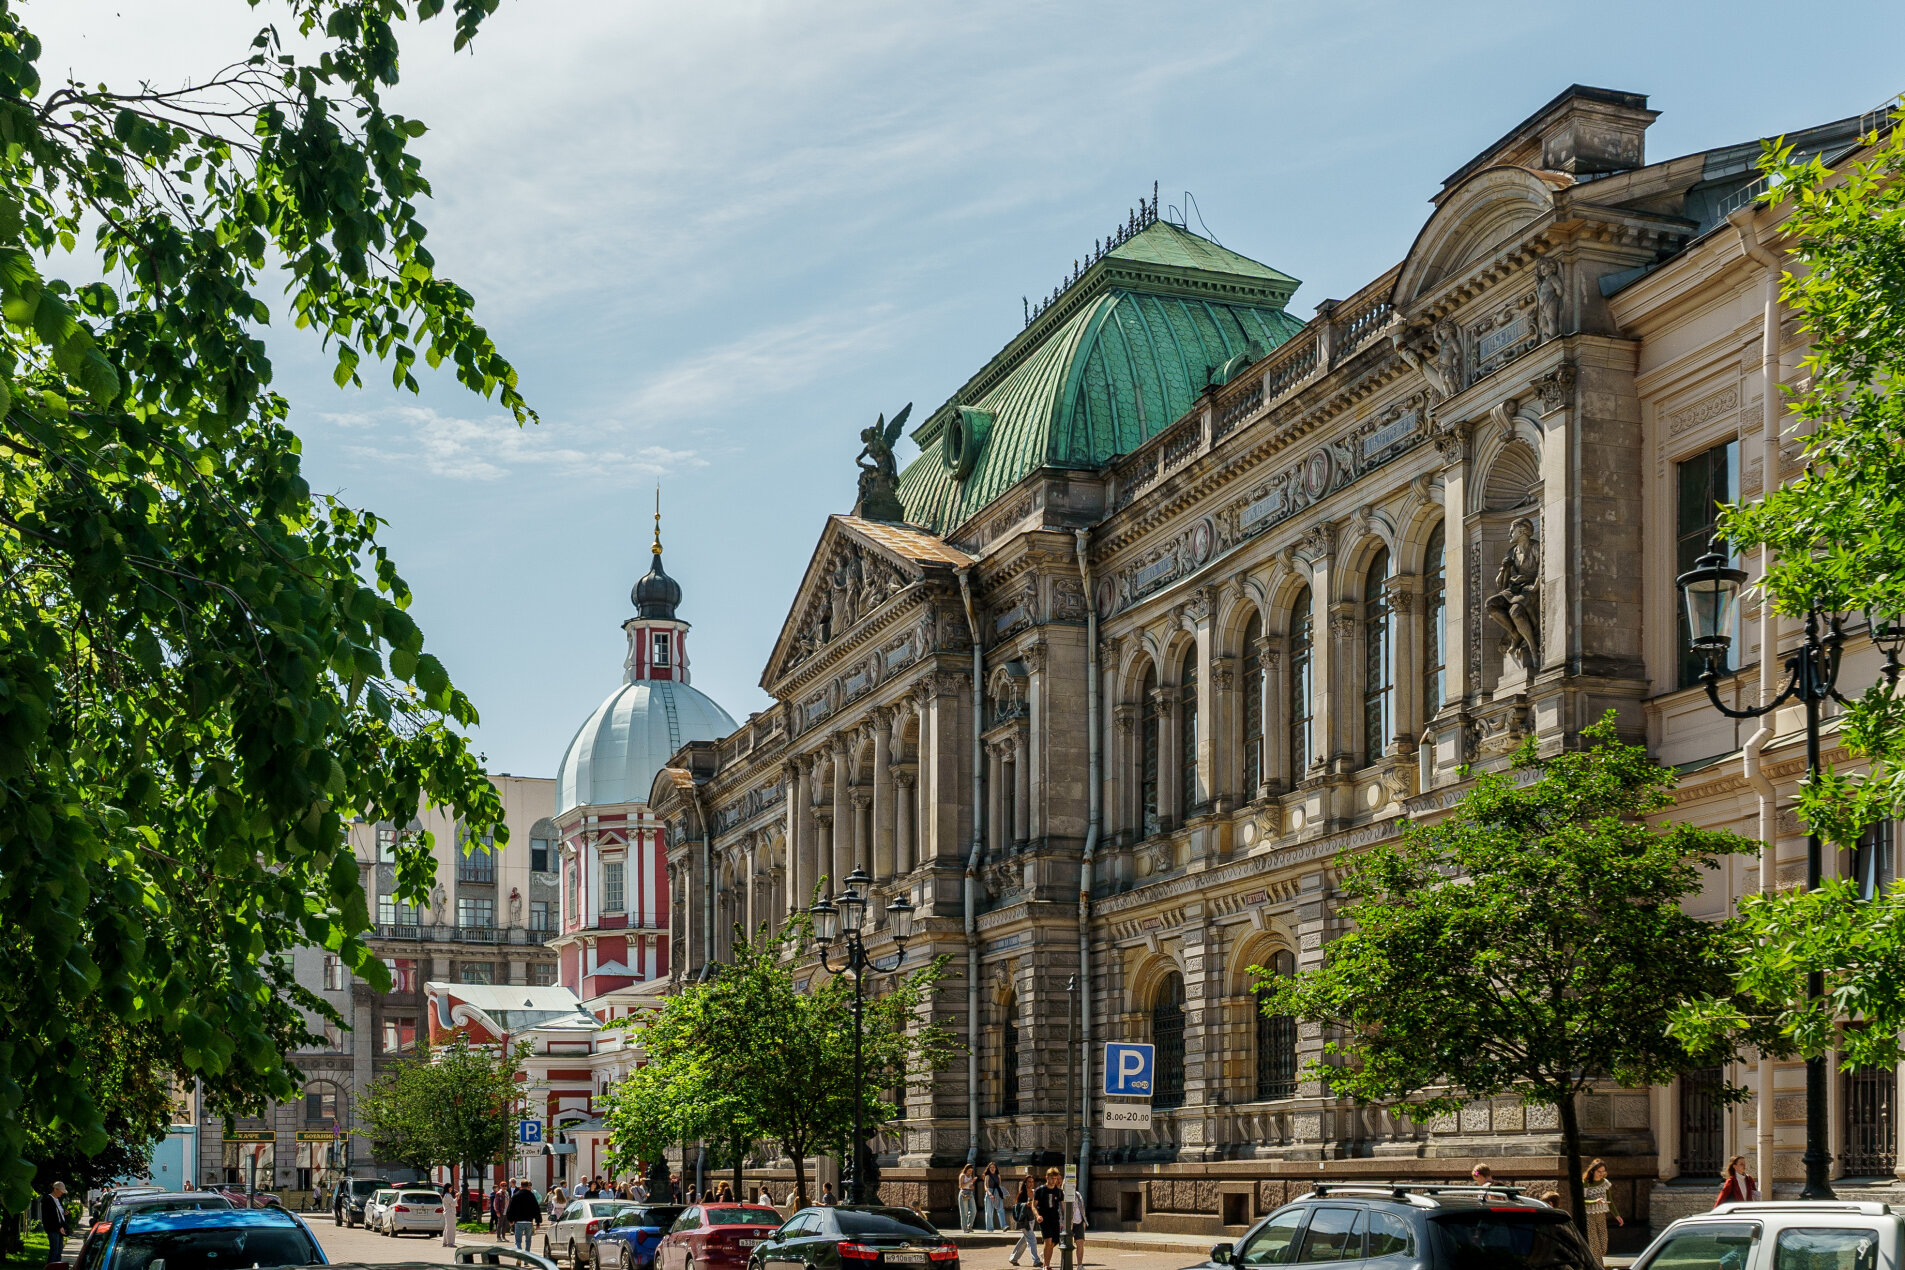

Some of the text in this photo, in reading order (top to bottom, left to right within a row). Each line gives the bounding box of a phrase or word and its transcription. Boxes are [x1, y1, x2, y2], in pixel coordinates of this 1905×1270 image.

[1118, 1050, 1144, 1089] P
[1106, 1111, 1149, 1121] 8.00-20.00
[525, 1123, 538, 1140] P
